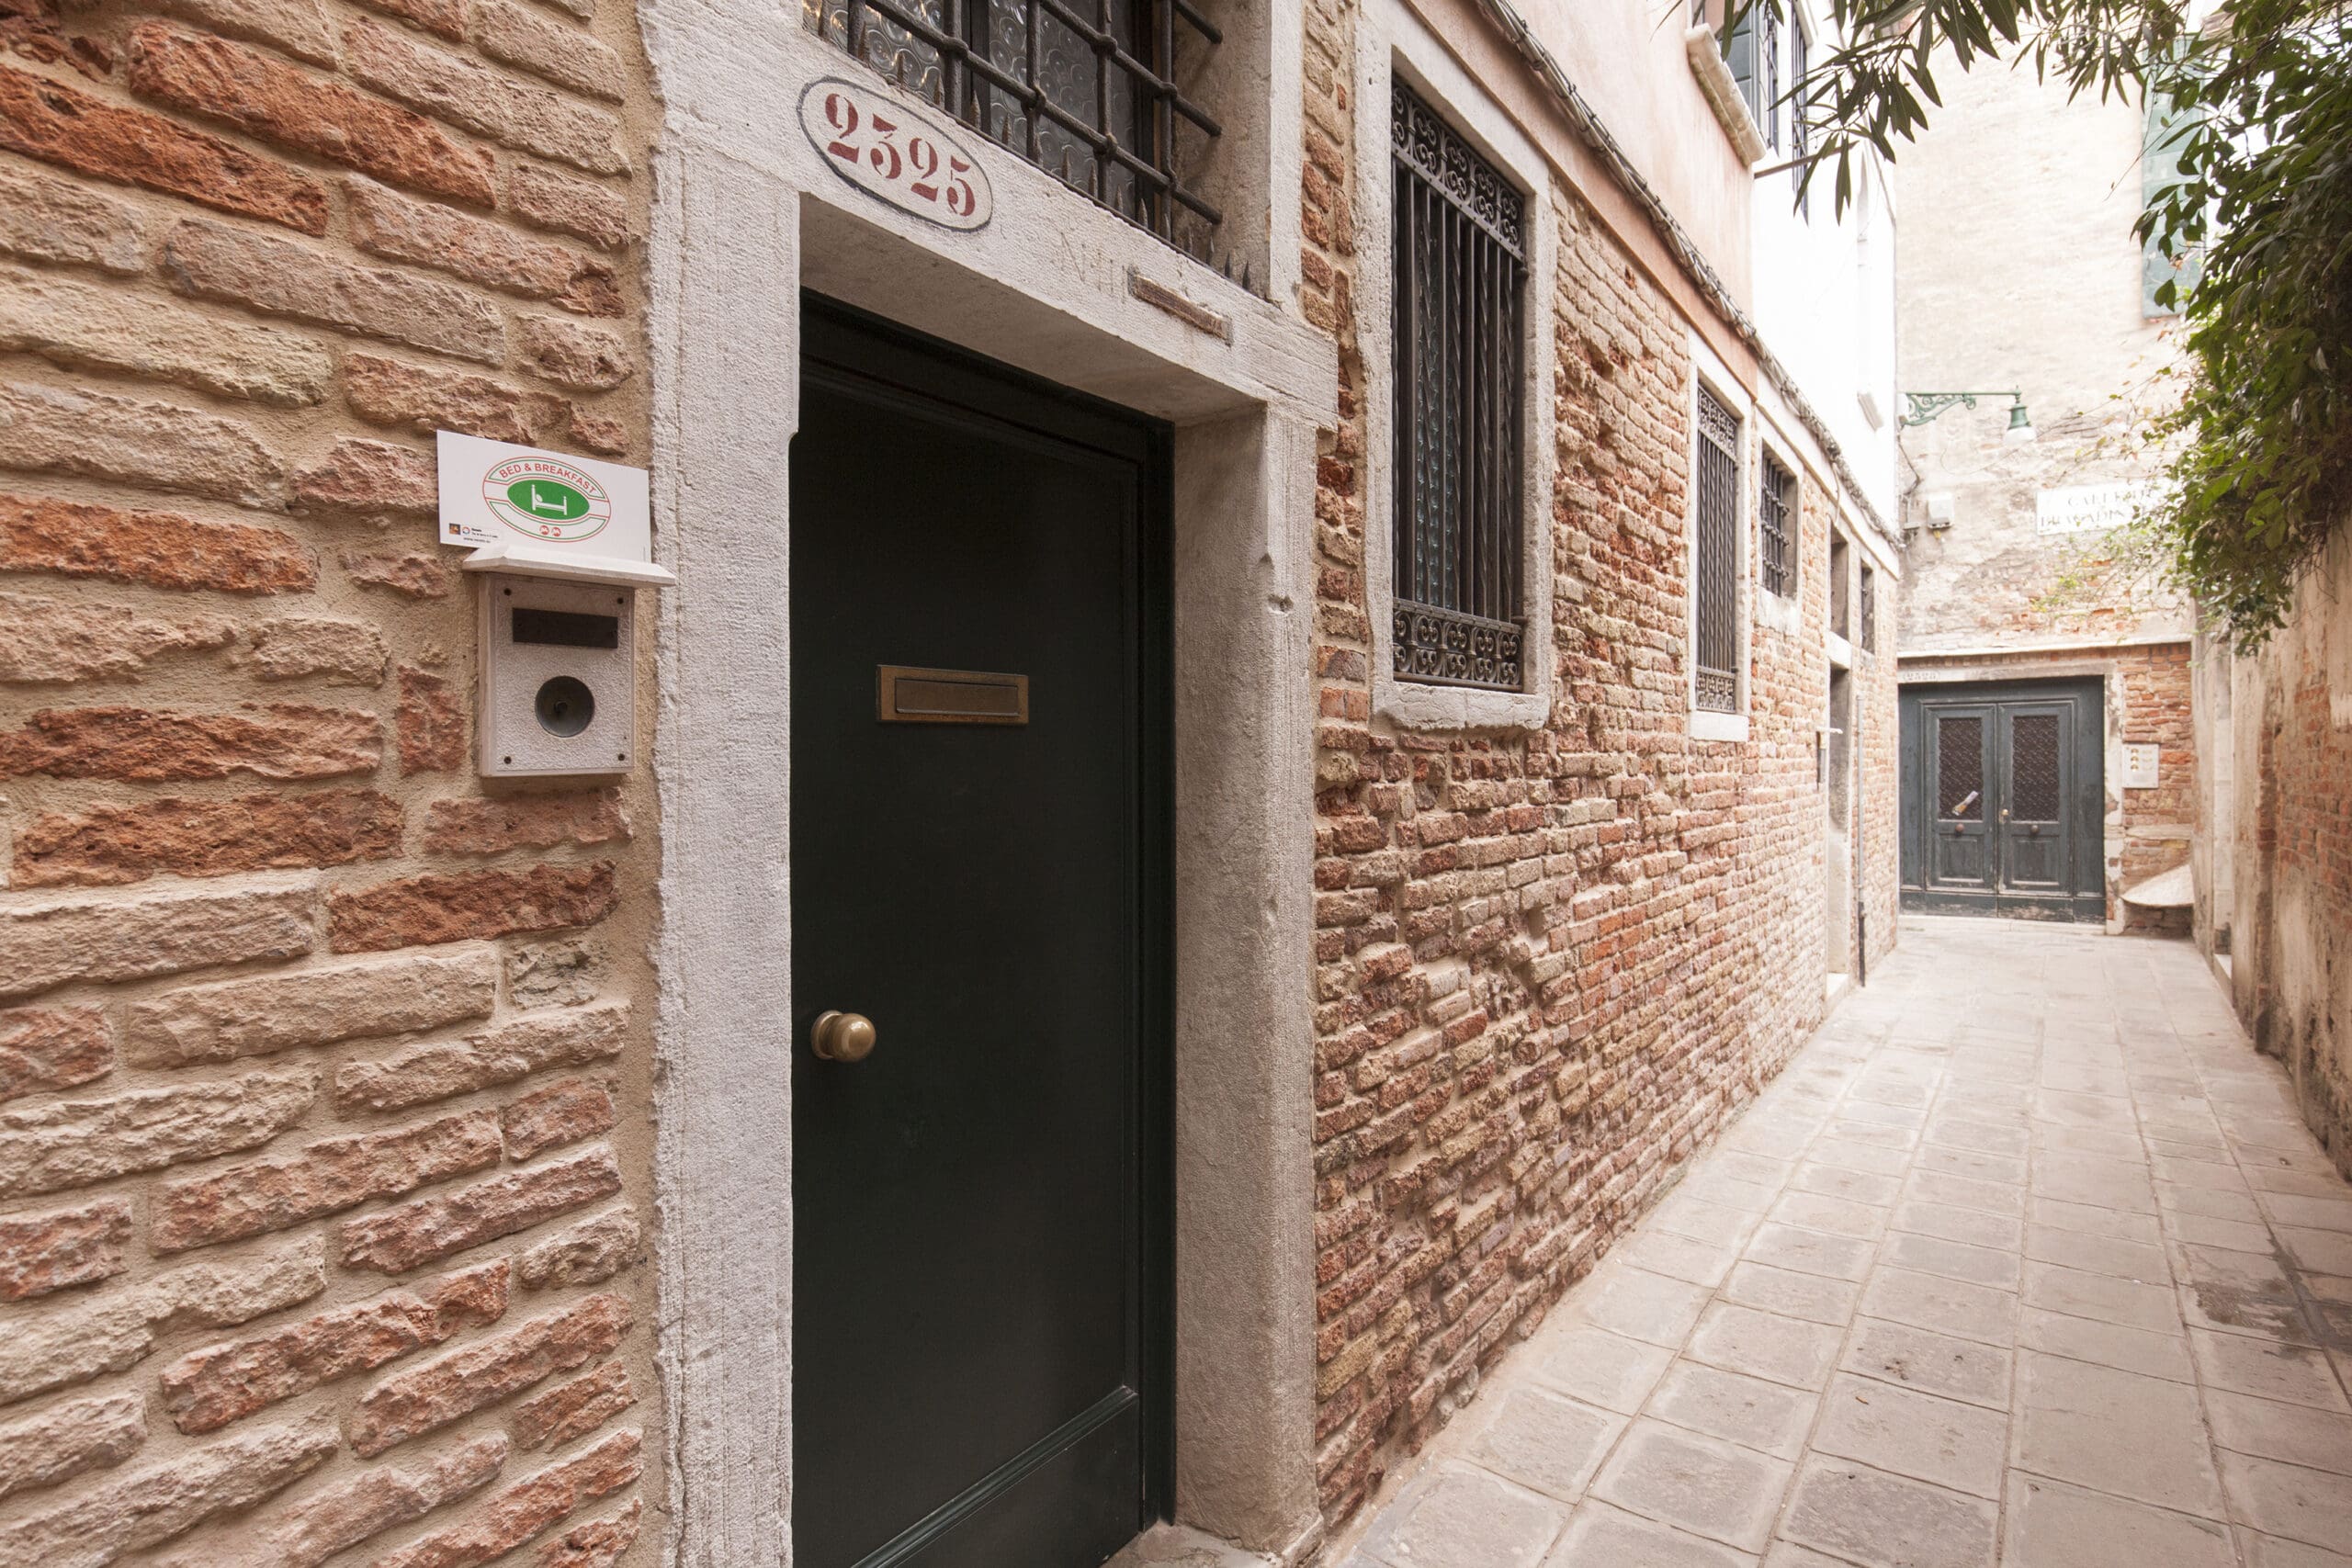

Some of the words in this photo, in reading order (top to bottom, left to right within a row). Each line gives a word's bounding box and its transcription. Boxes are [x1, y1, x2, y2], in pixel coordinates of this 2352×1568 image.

[824, 93, 977, 217] 2325
[499, 464, 522, 479] BED
[524, 462, 532, 472] &
[535, 463, 596, 493] BREAKFAST
